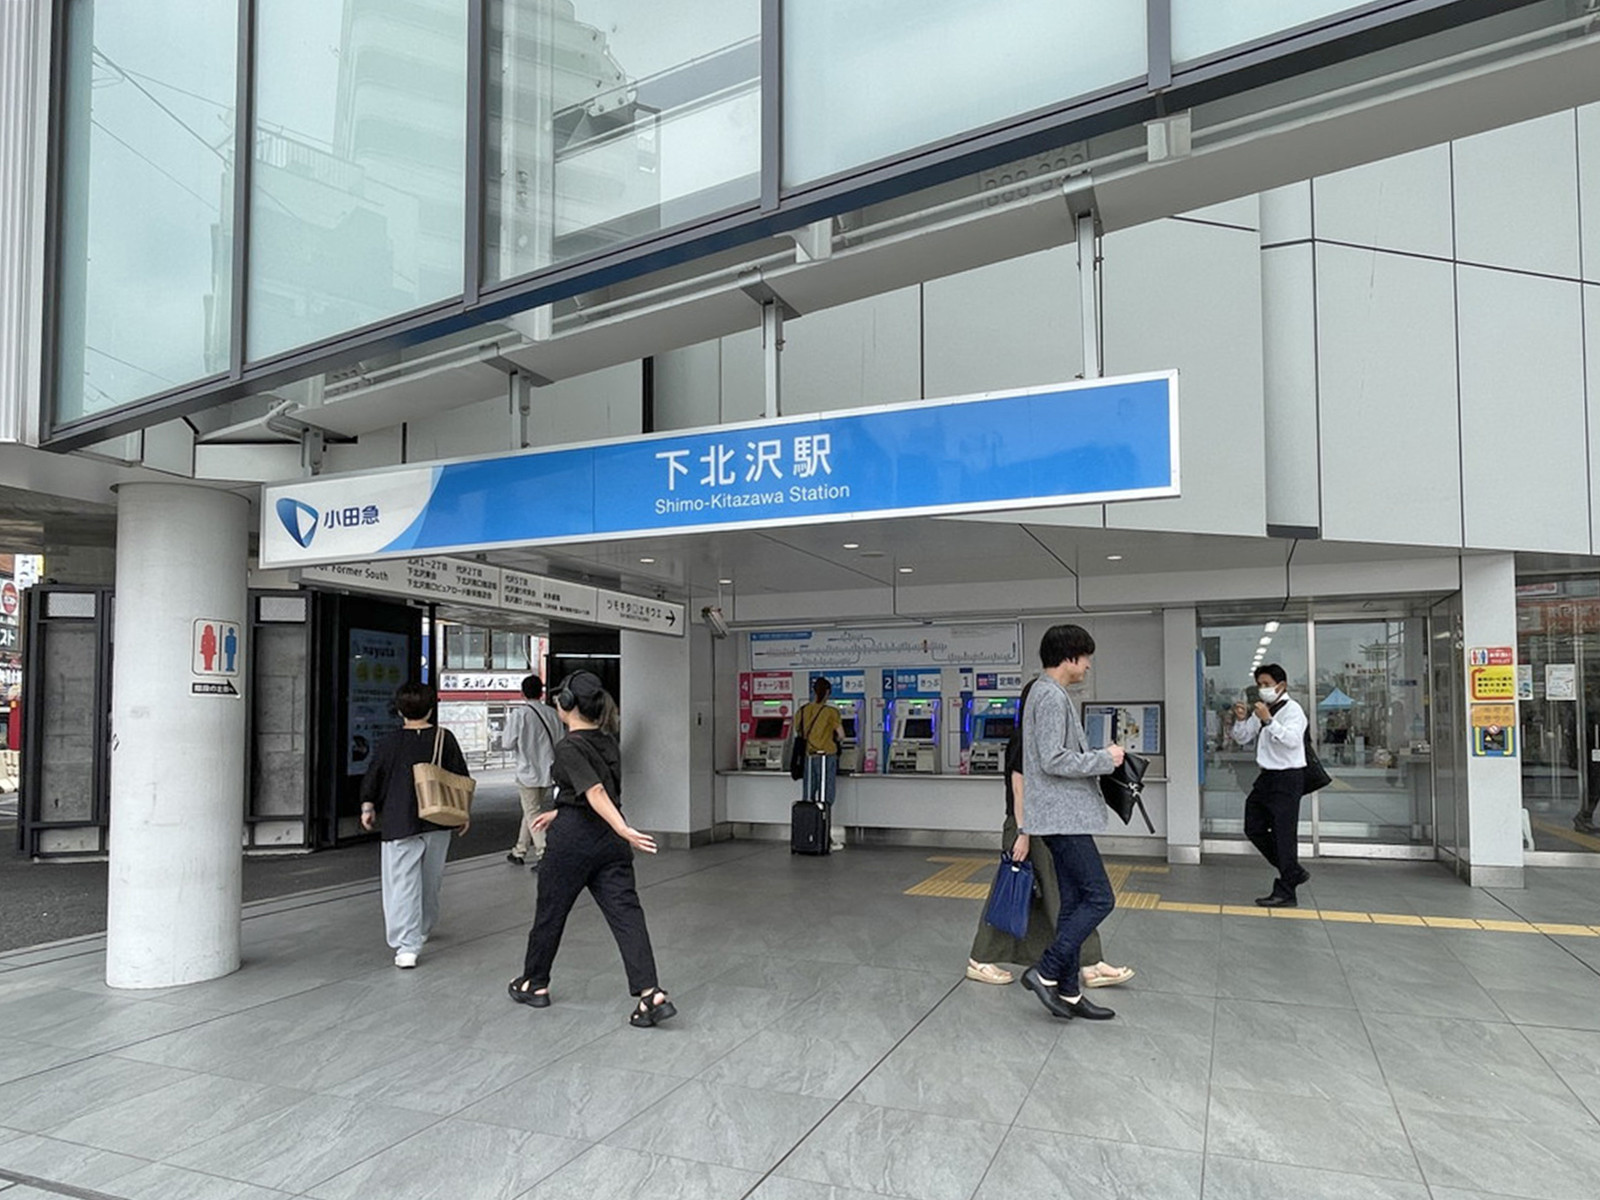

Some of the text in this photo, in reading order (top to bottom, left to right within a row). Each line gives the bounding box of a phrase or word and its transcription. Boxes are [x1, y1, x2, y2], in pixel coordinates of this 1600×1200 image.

[655, 433, 832, 491] 下北沢駅
[655, 483, 850, 515] Shimo-Kitazawa Station
[324, 505, 380, 529] 小田急
[331, 565, 363, 577] Former
[365, 568, 389, 581] South
[884, 677, 892, 689] 2
[963, 676, 969, 688] 1
